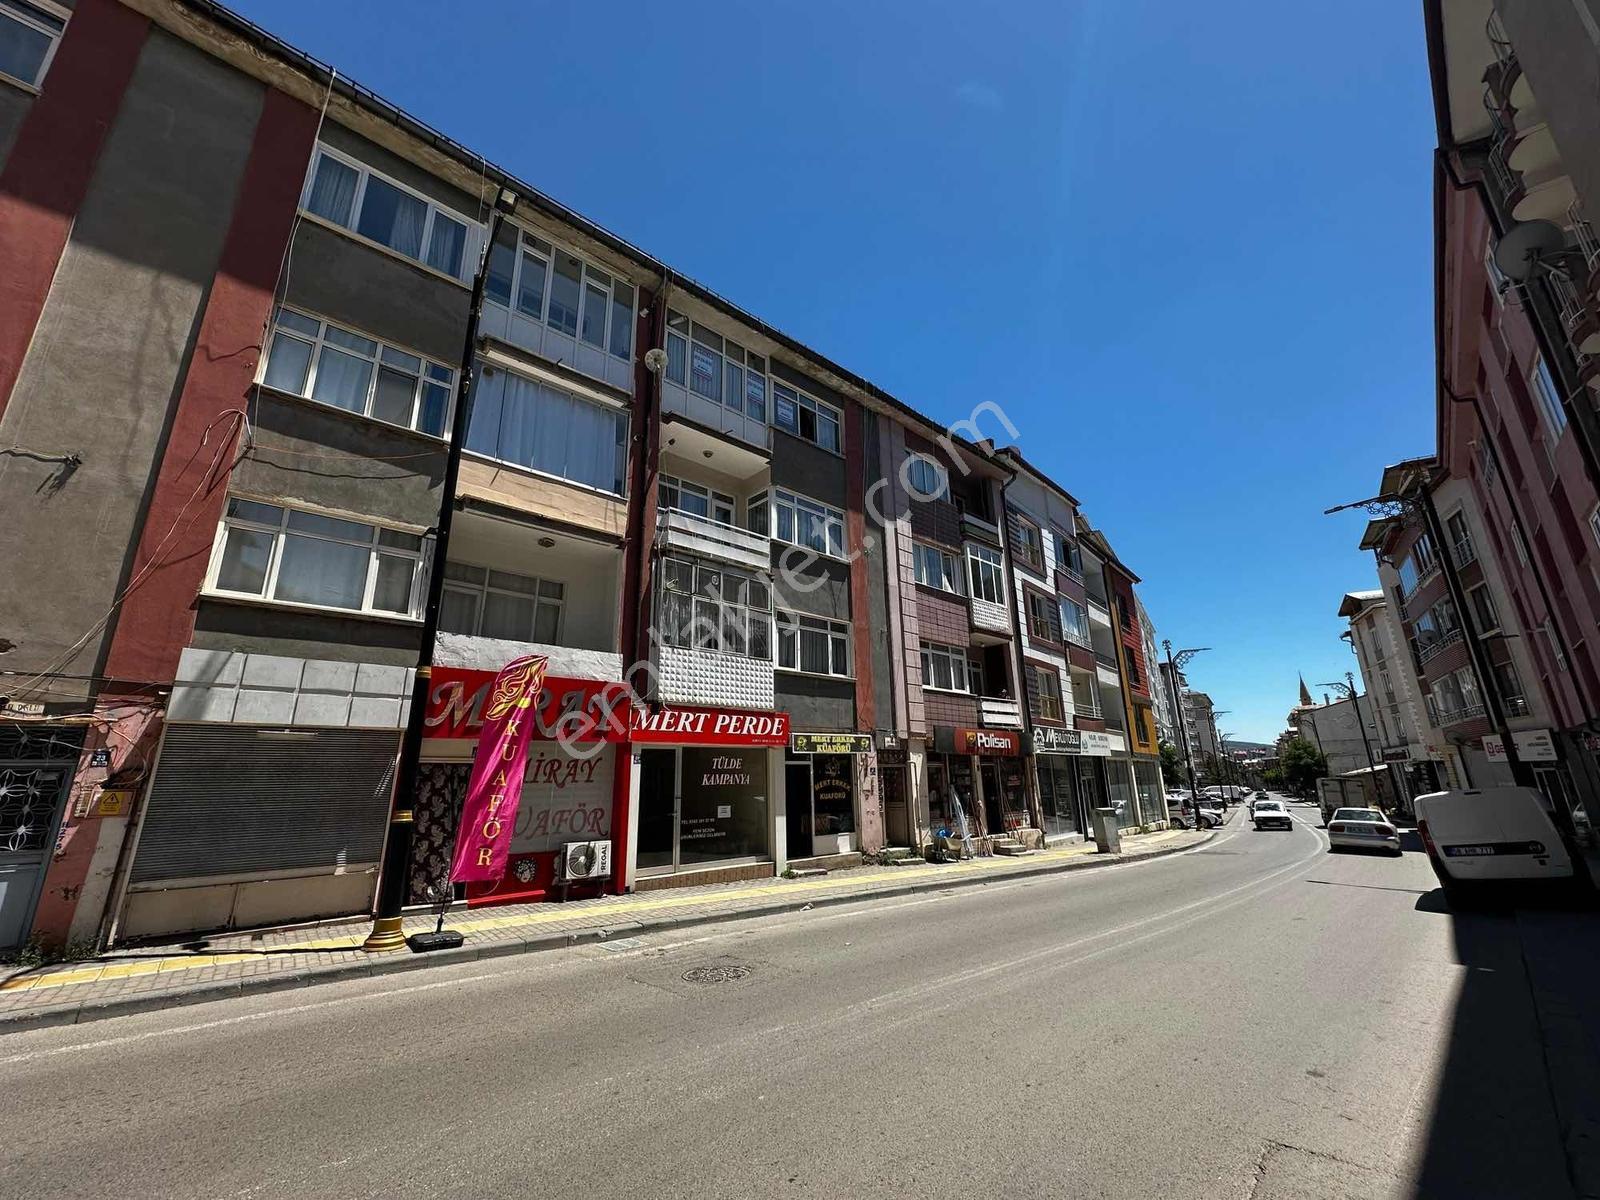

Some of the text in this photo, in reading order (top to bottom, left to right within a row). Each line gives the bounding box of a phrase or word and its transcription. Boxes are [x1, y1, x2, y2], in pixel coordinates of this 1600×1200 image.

[424, 681, 628, 738] MRAY
[632, 709, 785, 736] MERT PERDE
[976, 732, 1011, 749] Polisan
[711, 756, 743, 770] TÜLDE
[701, 773, 751, 786] KAMPANYA
[476, 719, 522, 866] KUAFÖR
